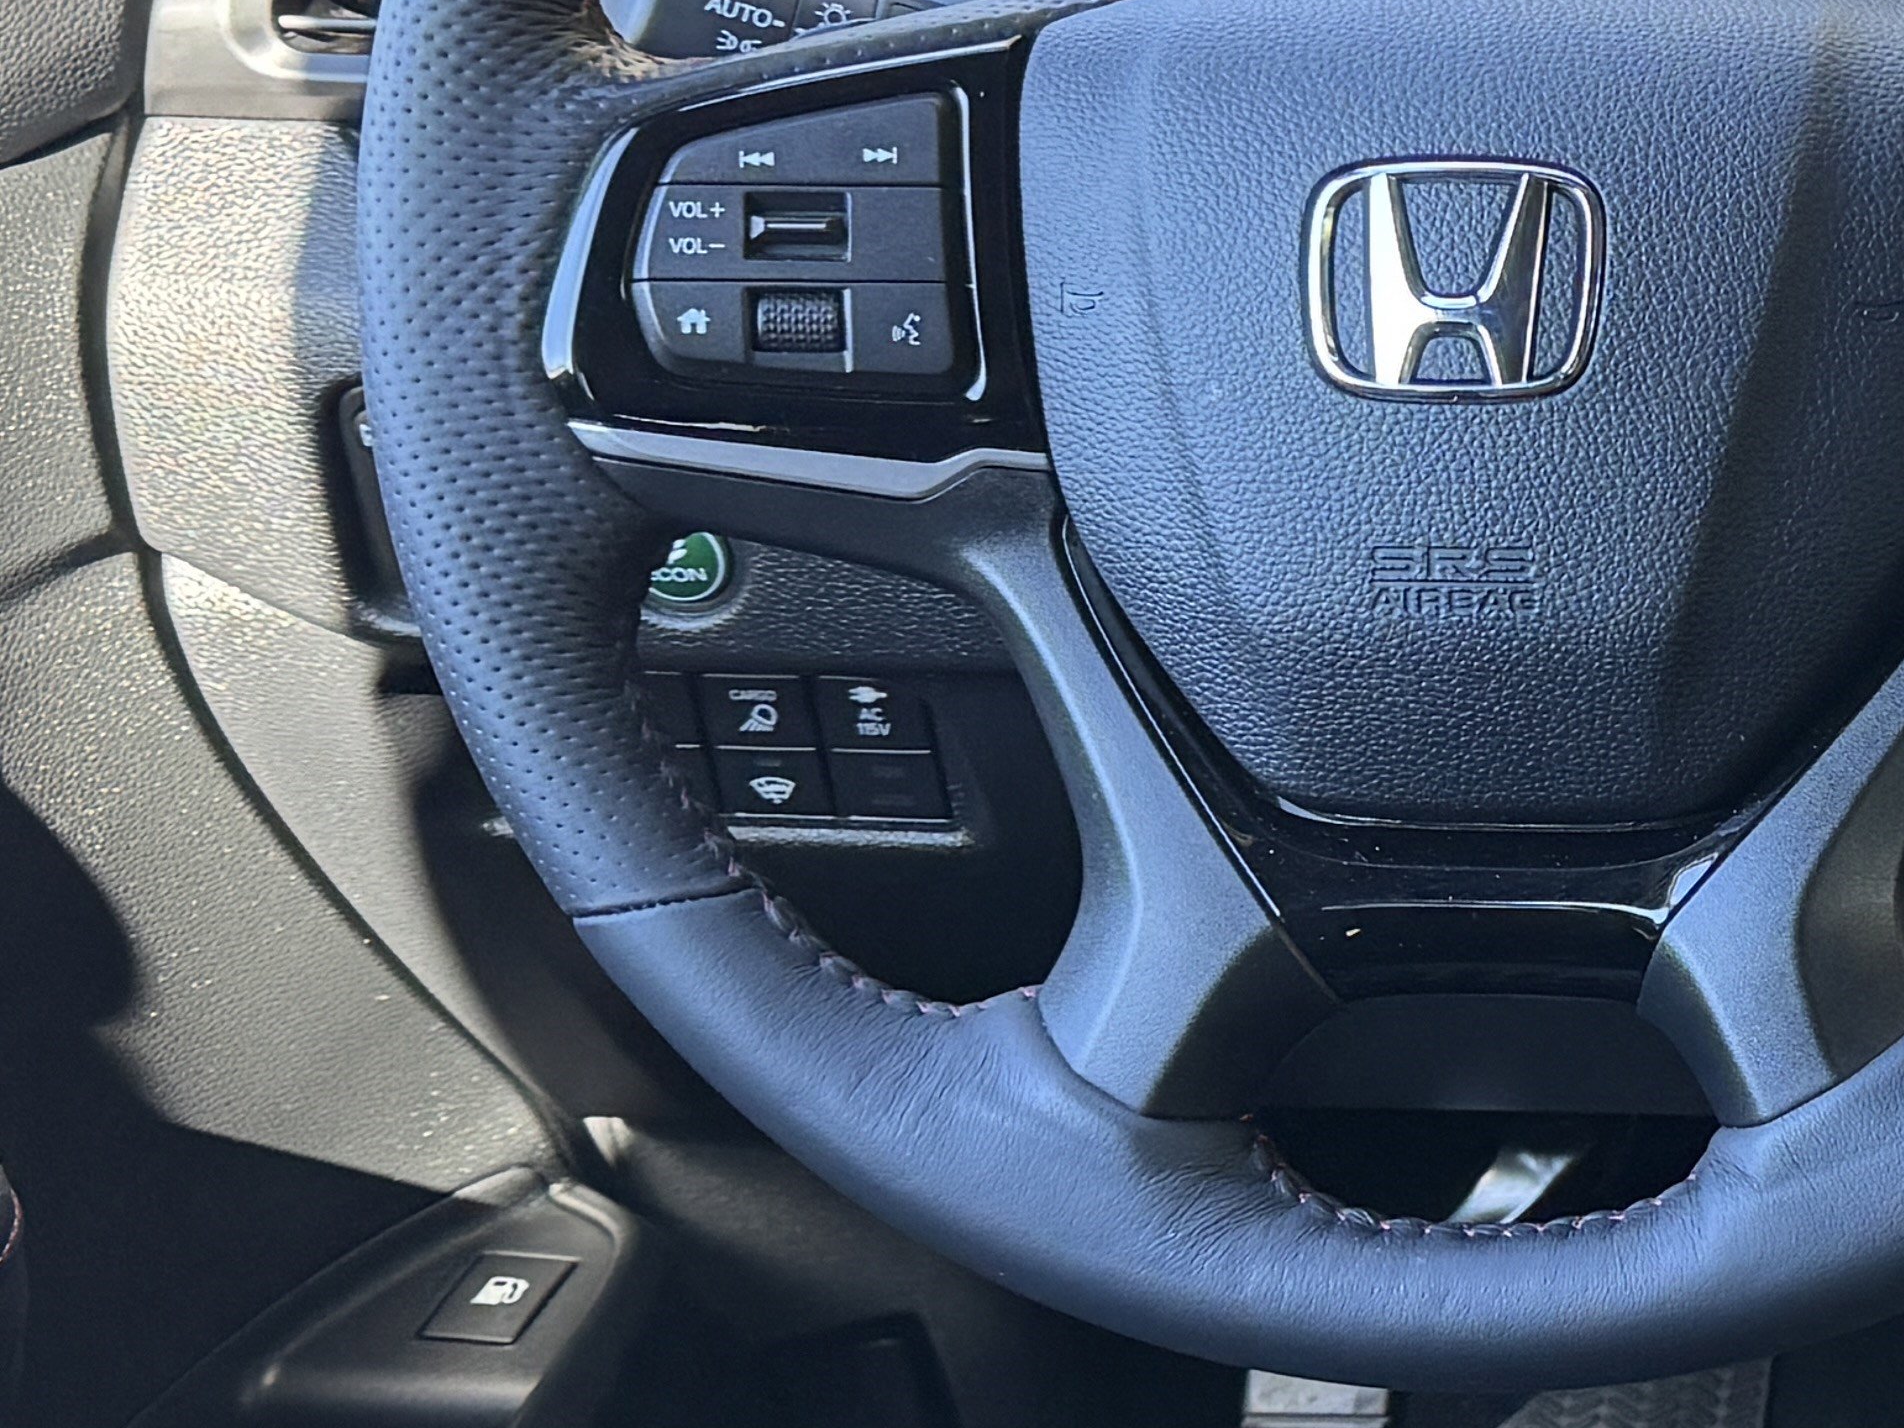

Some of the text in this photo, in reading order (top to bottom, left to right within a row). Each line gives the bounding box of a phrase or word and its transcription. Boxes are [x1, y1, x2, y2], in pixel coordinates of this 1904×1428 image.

[1369, 544, 1535, 580] SRS
[1371, 586, 1544, 615] AIRBAG
[858, 708, 884, 722] AC
[857, 722, 891, 736] 115V
